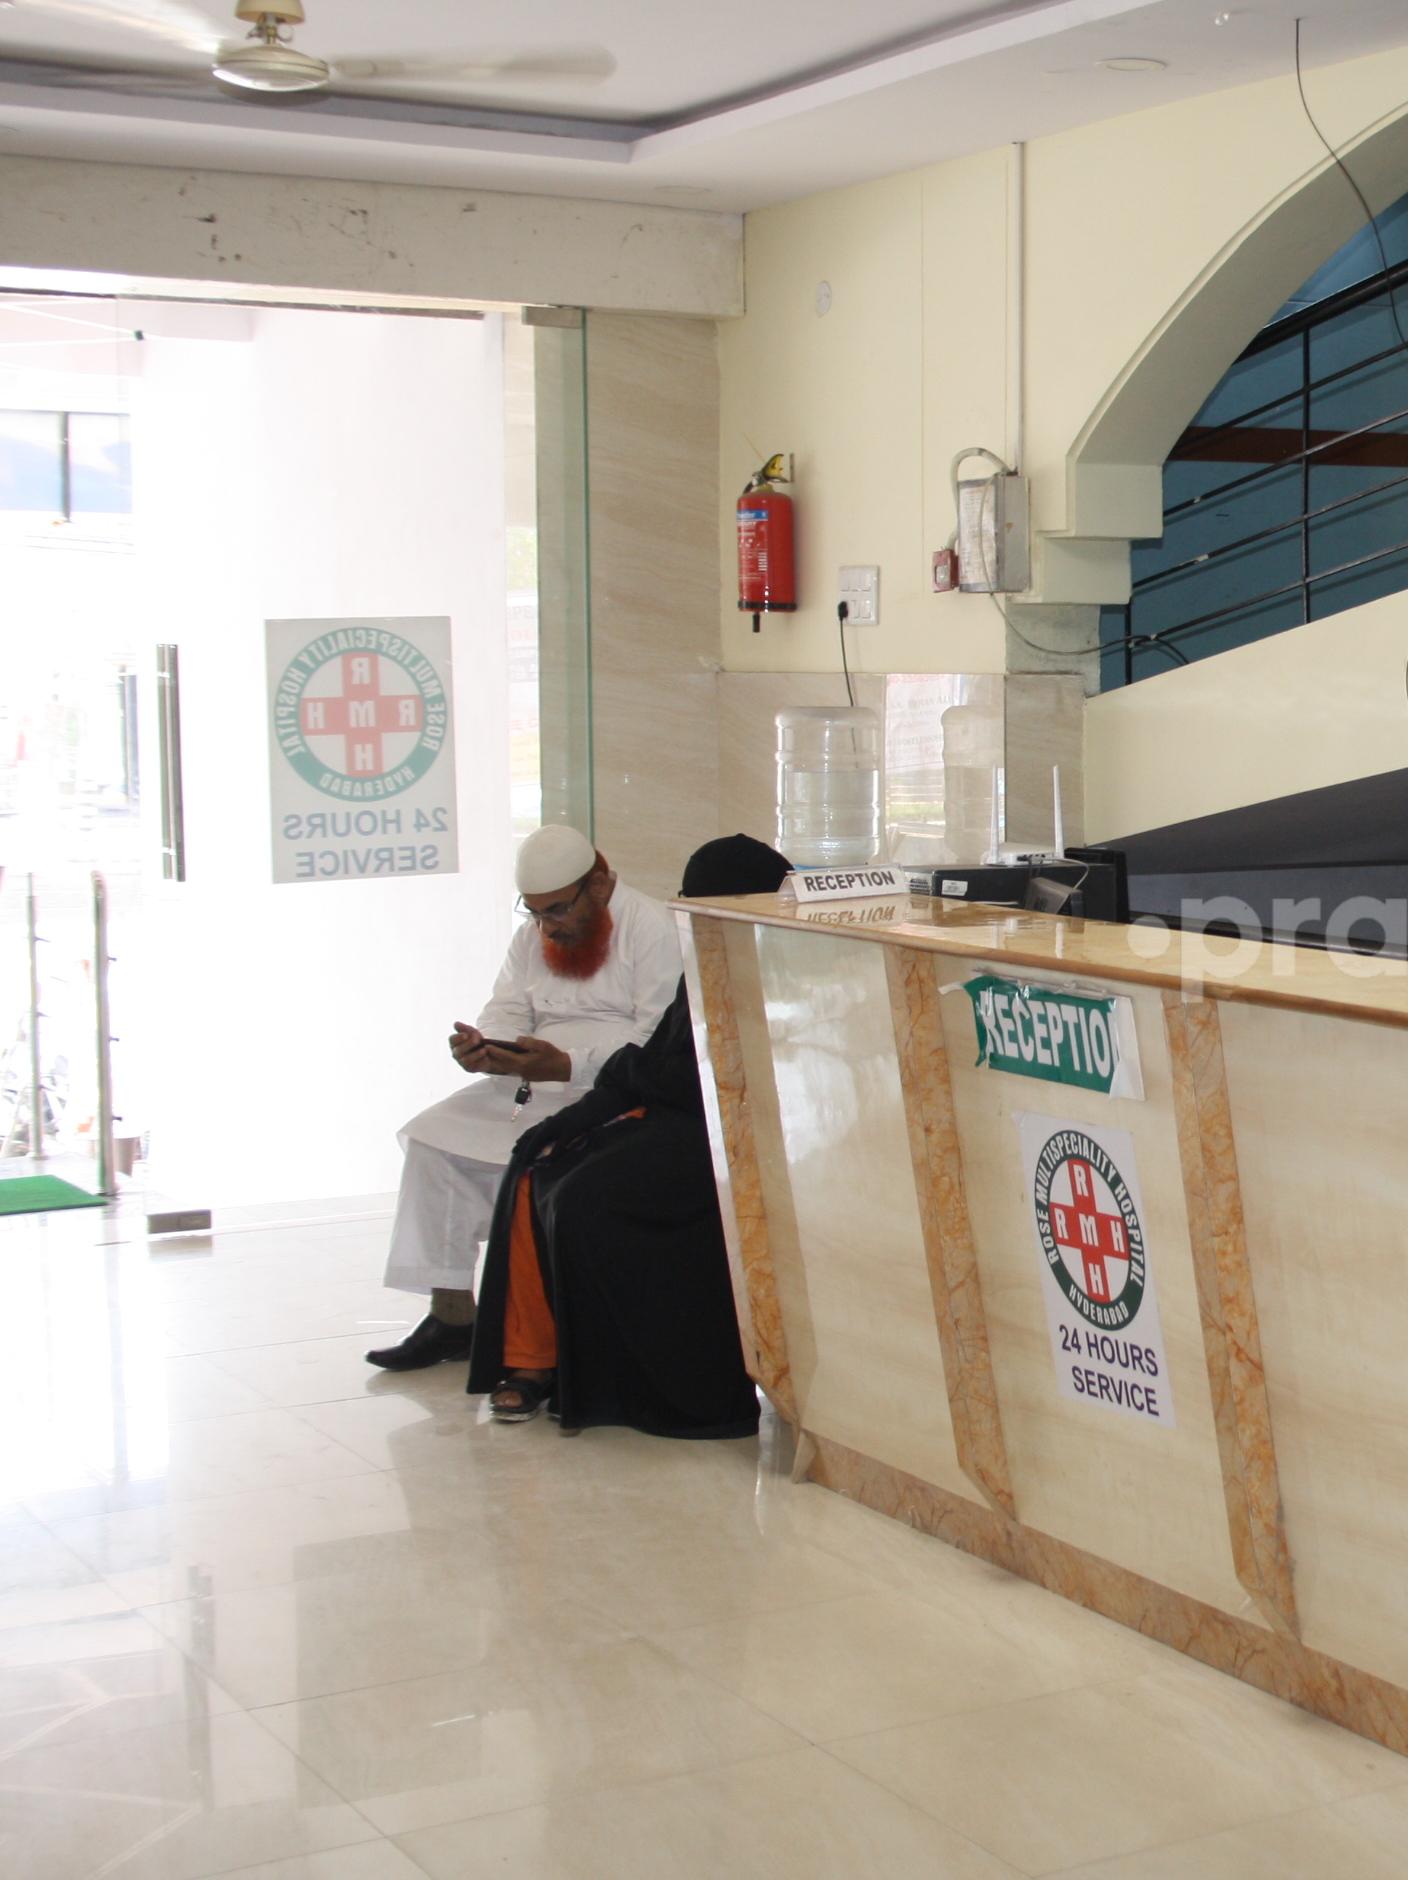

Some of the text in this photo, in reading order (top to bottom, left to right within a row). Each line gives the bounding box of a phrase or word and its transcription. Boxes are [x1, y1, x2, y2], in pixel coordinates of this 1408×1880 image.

[804, 870, 896, 892] RECEPTION
[1073, 1164, 1089, 1197] R
[1035, 1132, 1144, 1287] ROSE MULTISPECIALITY HOSPITAL
[1069, 1283, 1130, 1326] HYDERABAD
[1059, 1324, 1159, 1377] 24 HOURS
[1071, 1365, 1160, 1417] SERVICE
